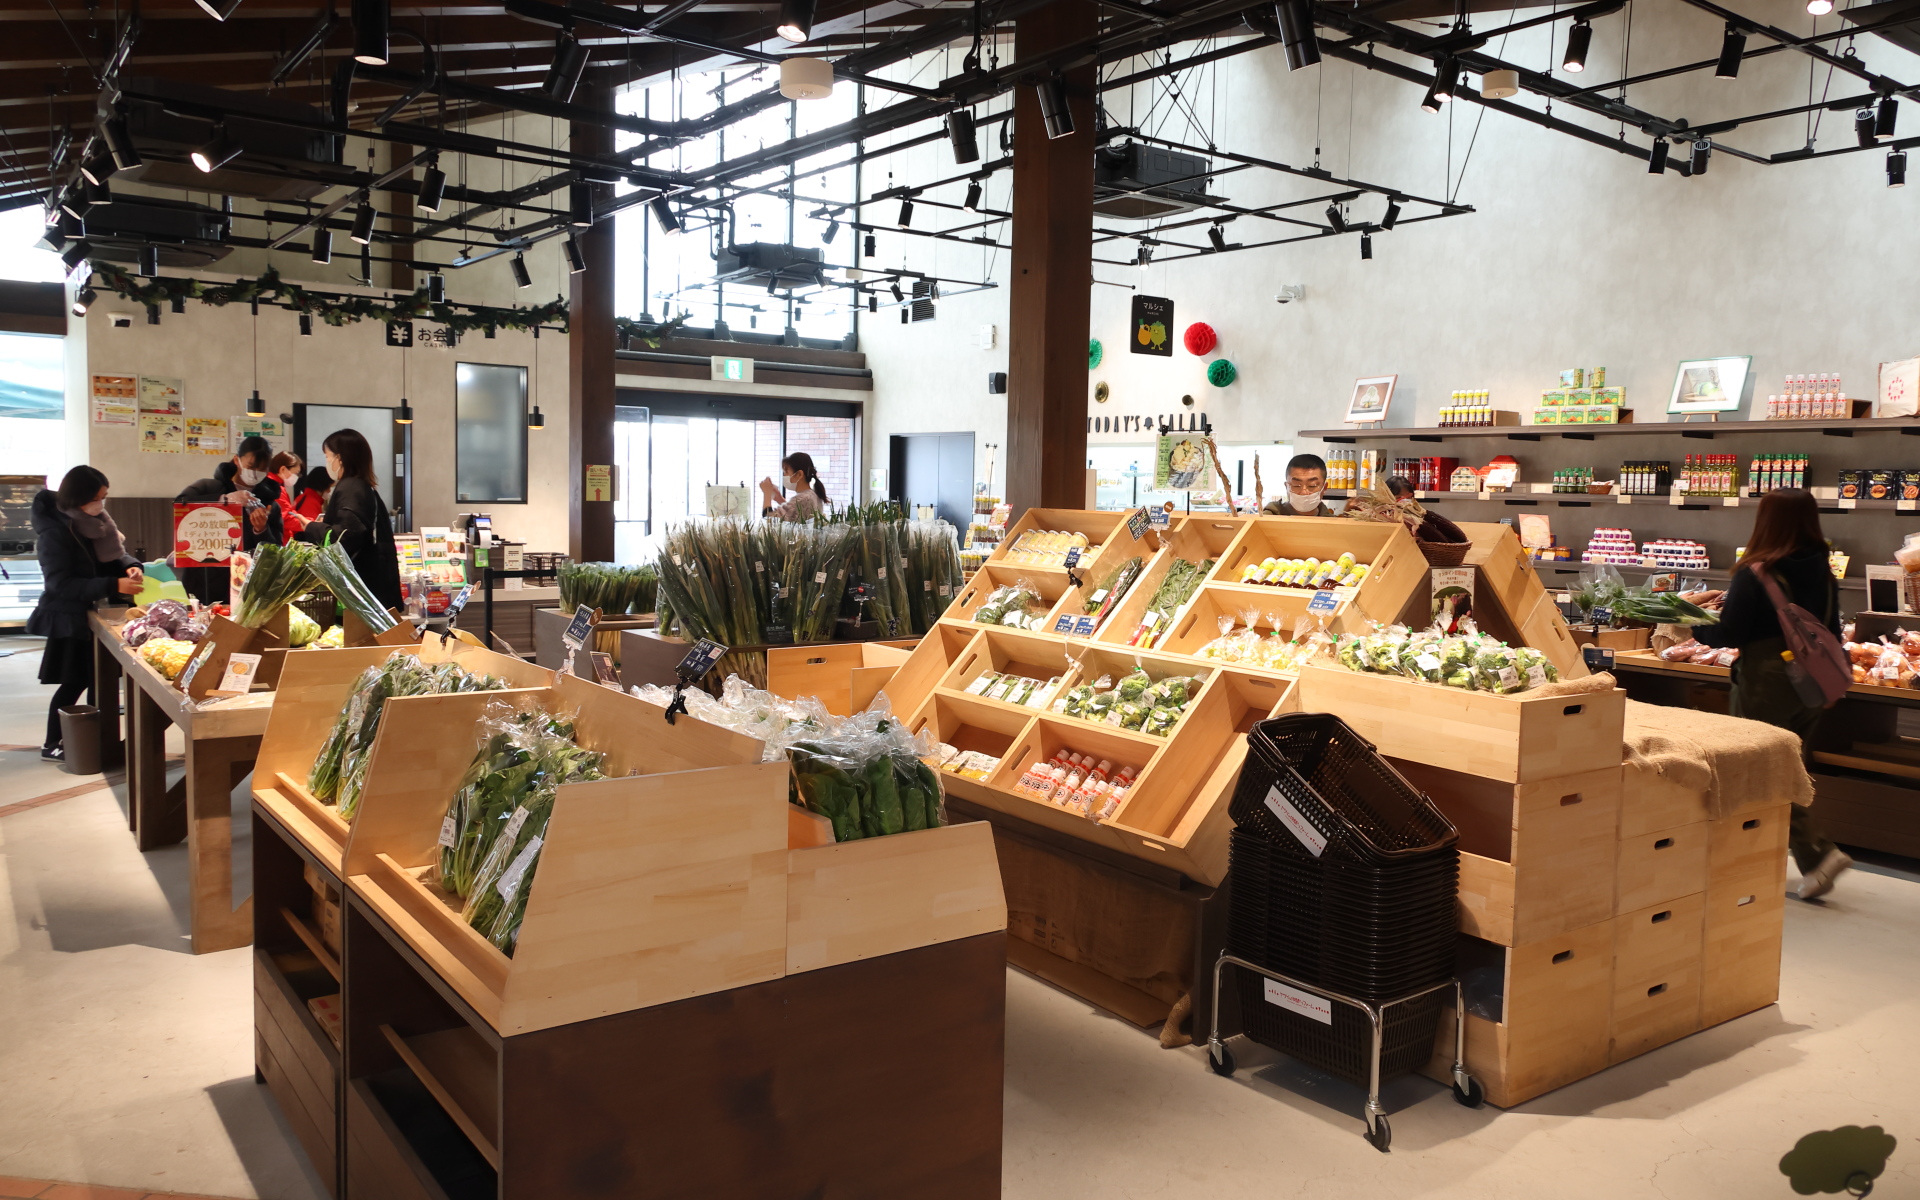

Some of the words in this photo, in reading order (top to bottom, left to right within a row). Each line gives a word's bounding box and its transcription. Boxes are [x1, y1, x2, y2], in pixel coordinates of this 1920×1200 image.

[1143, 302, 1164, 311] マルシェ
[1158, 413, 1208, 432] SALAD
[189, 520, 228, 529] つめ放題
[197, 538, 233, 551] 200円
